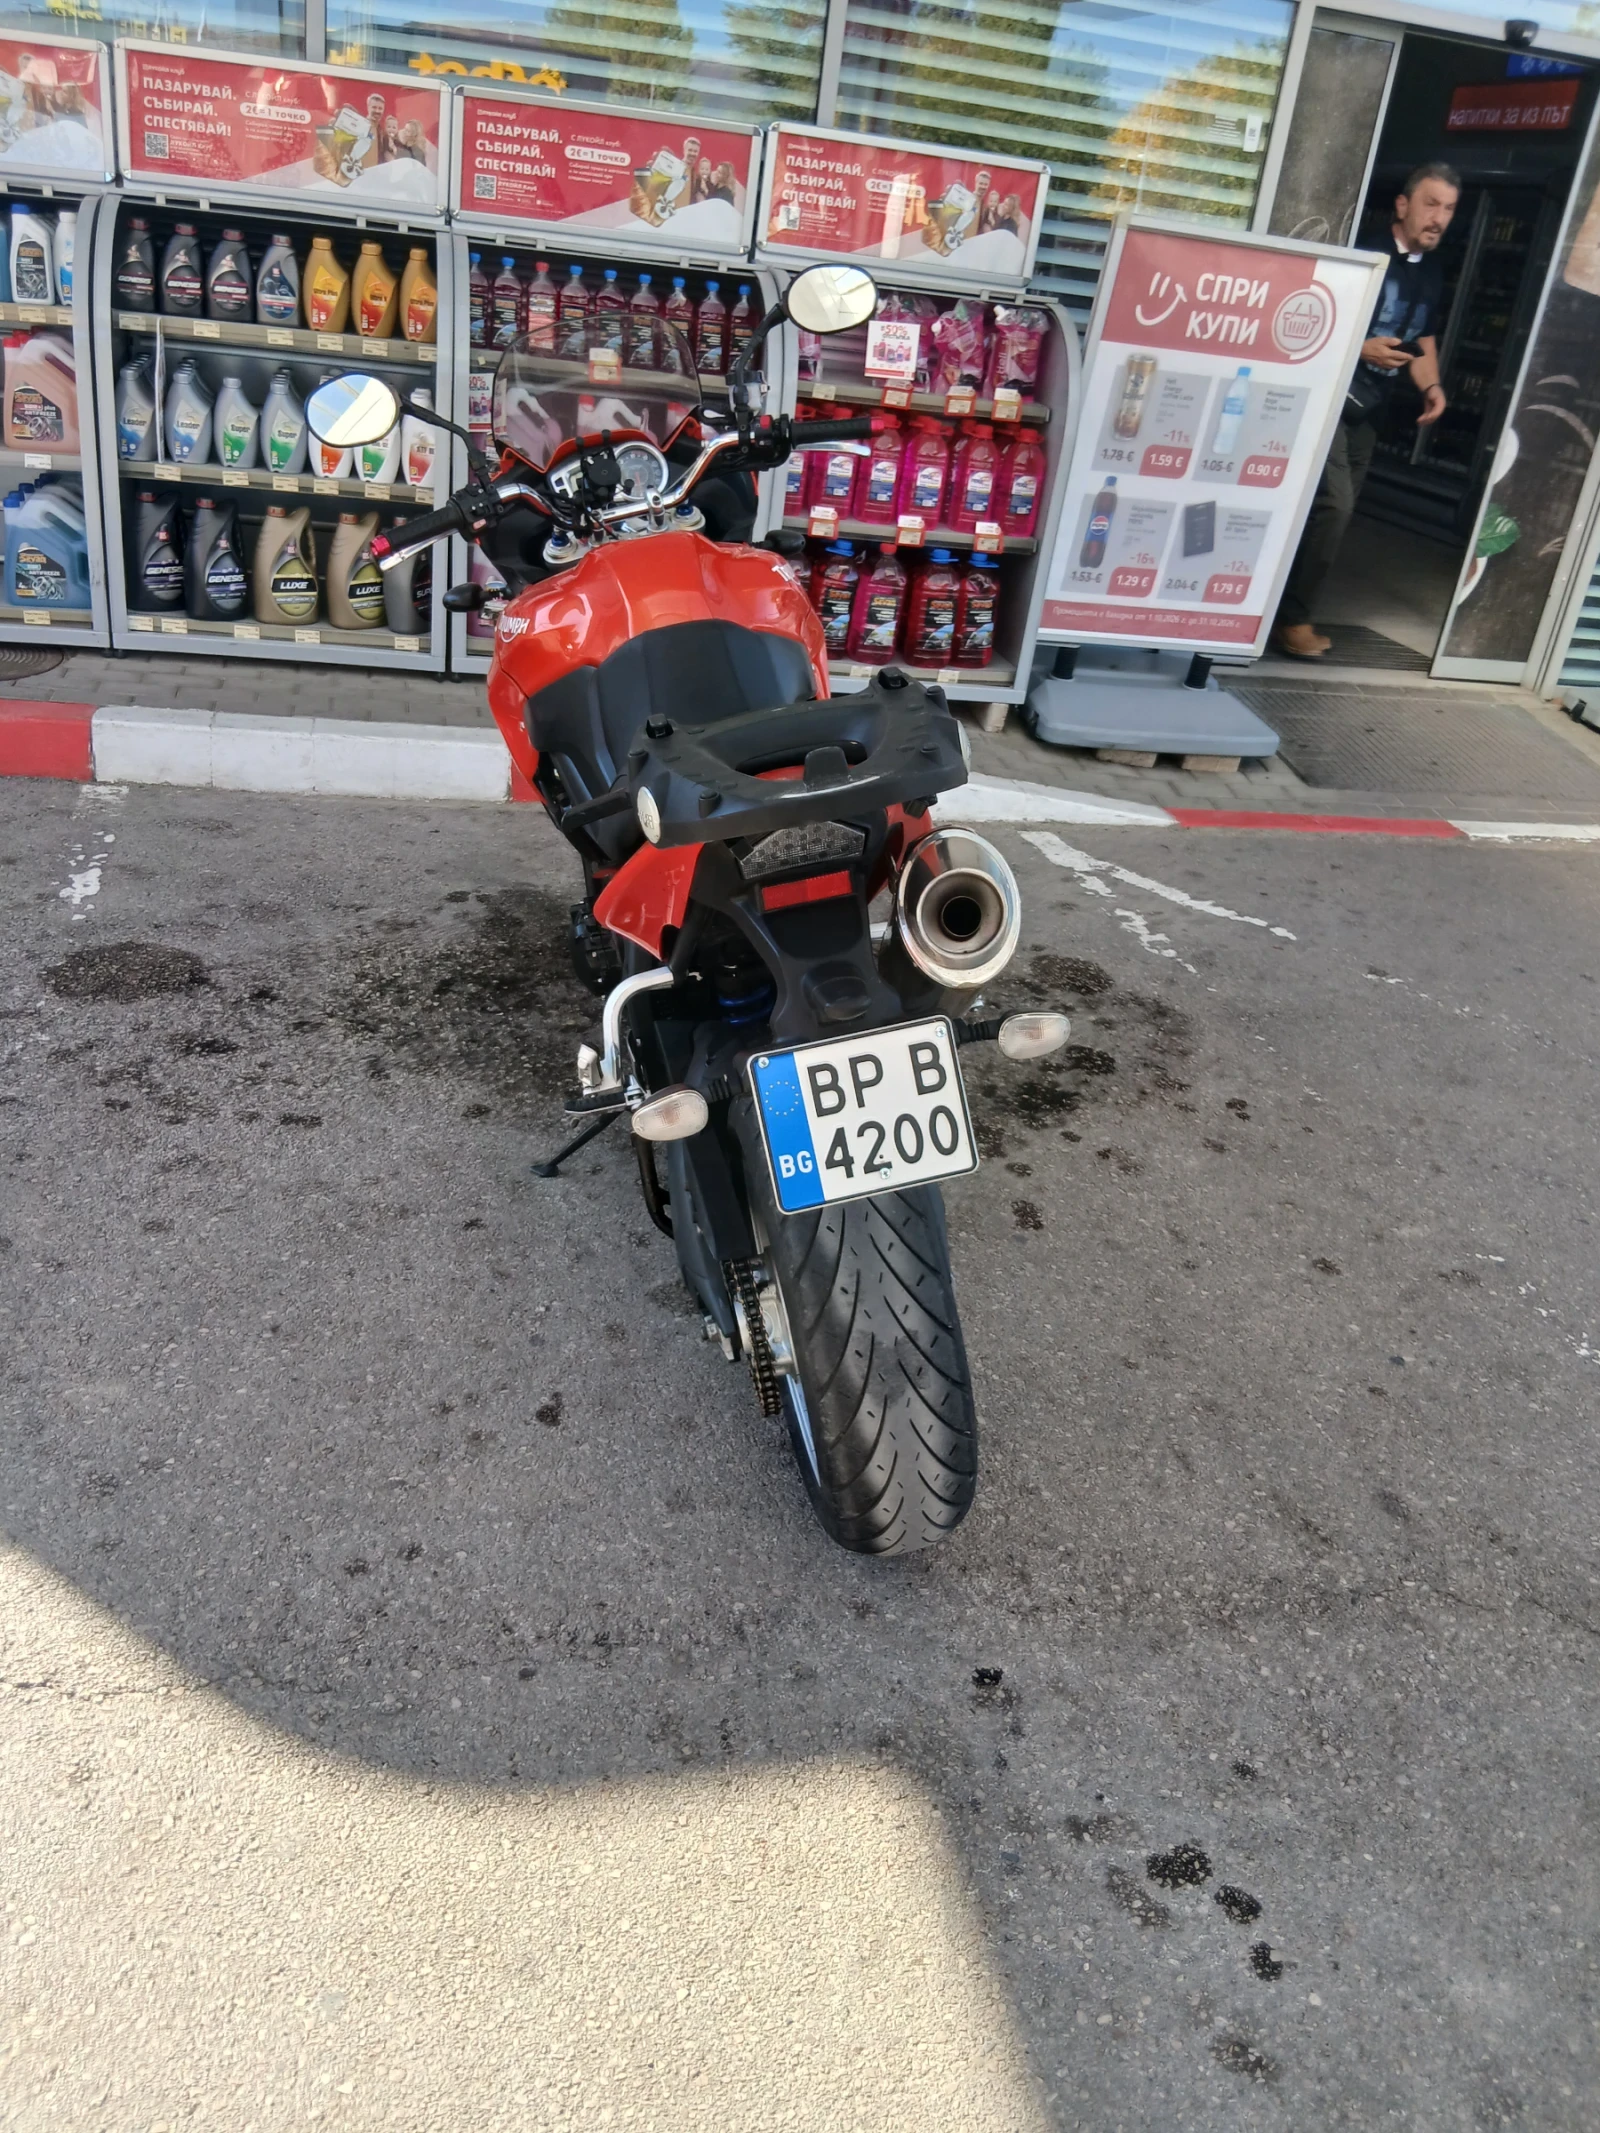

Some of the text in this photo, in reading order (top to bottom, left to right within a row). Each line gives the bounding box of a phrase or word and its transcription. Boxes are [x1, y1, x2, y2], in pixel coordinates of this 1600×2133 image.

[143, 77, 237, 101] ПАЗАРУВАЙ.
[144, 96, 218, 117] СЪБИРАЙ.
[276, 112, 306, 121] точка
[144, 118, 231, 137] СПЕСТЯВАЙ!
[477, 121, 563, 144] ПАЗАРУВАЙ.
[476, 139, 544, 158] СЪБИРАЙ.
[597, 154, 626, 163] точка
[785, 155, 864, 177] ПАЗАРУВАЙ.
[475, 157, 556, 178] СПЕСТЯВАЙ!
[784, 172, 846, 191] СЪБИРАЙ.
[782, 189, 856, 210] СПЕСТЯВАЙ!
[1196, 273, 1269, 309] СПРИ
[1185, 310, 1260, 346] КУПИ
[123, 417, 148, 426] Leader
[176, 420, 201, 430] Leader
[230, 424, 251, 433] Super
[278, 429, 298, 439] Super
[1150, 454, 1183, 467] 1.59 €
[1247, 463, 1281, 477] 0.90 €
[146, 566, 184, 575] GENESIS
[208, 574, 244, 583] GENESIS
[280, 581, 309, 590] LUXE
[1116, 575, 1149, 587] 1.29 €
[1213, 582, 1243, 595] 1.79 €
[356, 586, 382, 596] LUXE
[807, 1041, 947, 1117] BP B
[824, 1104, 959, 1178] 4200
[778, 1151, 815, 1179] BG
